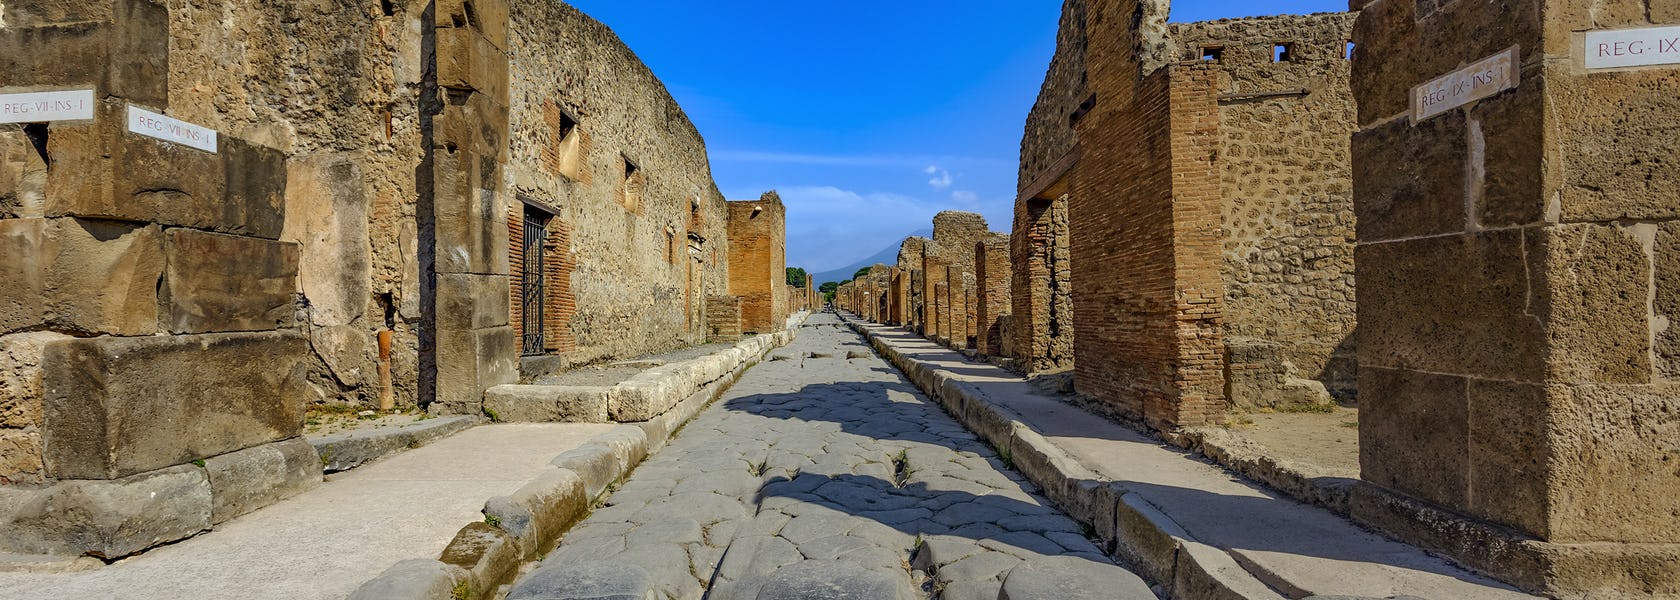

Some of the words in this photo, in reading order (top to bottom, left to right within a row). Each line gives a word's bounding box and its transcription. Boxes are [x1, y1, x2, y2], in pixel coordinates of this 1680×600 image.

[1599, 40, 1643, 57] REG
[1659, 37, 1679, 53] IX
[1421, 89, 1445, 109] REG
[1452, 80, 1464, 97] IX
[1472, 70, 1492, 89] INS
[4, 103, 28, 114] REG
[34, 101, 48, 112] VII
[55, 100, 72, 111] INS
[139, 116, 162, 131] REG
[169, 123, 181, 136] VII
[186, 129, 200, 141] INS
